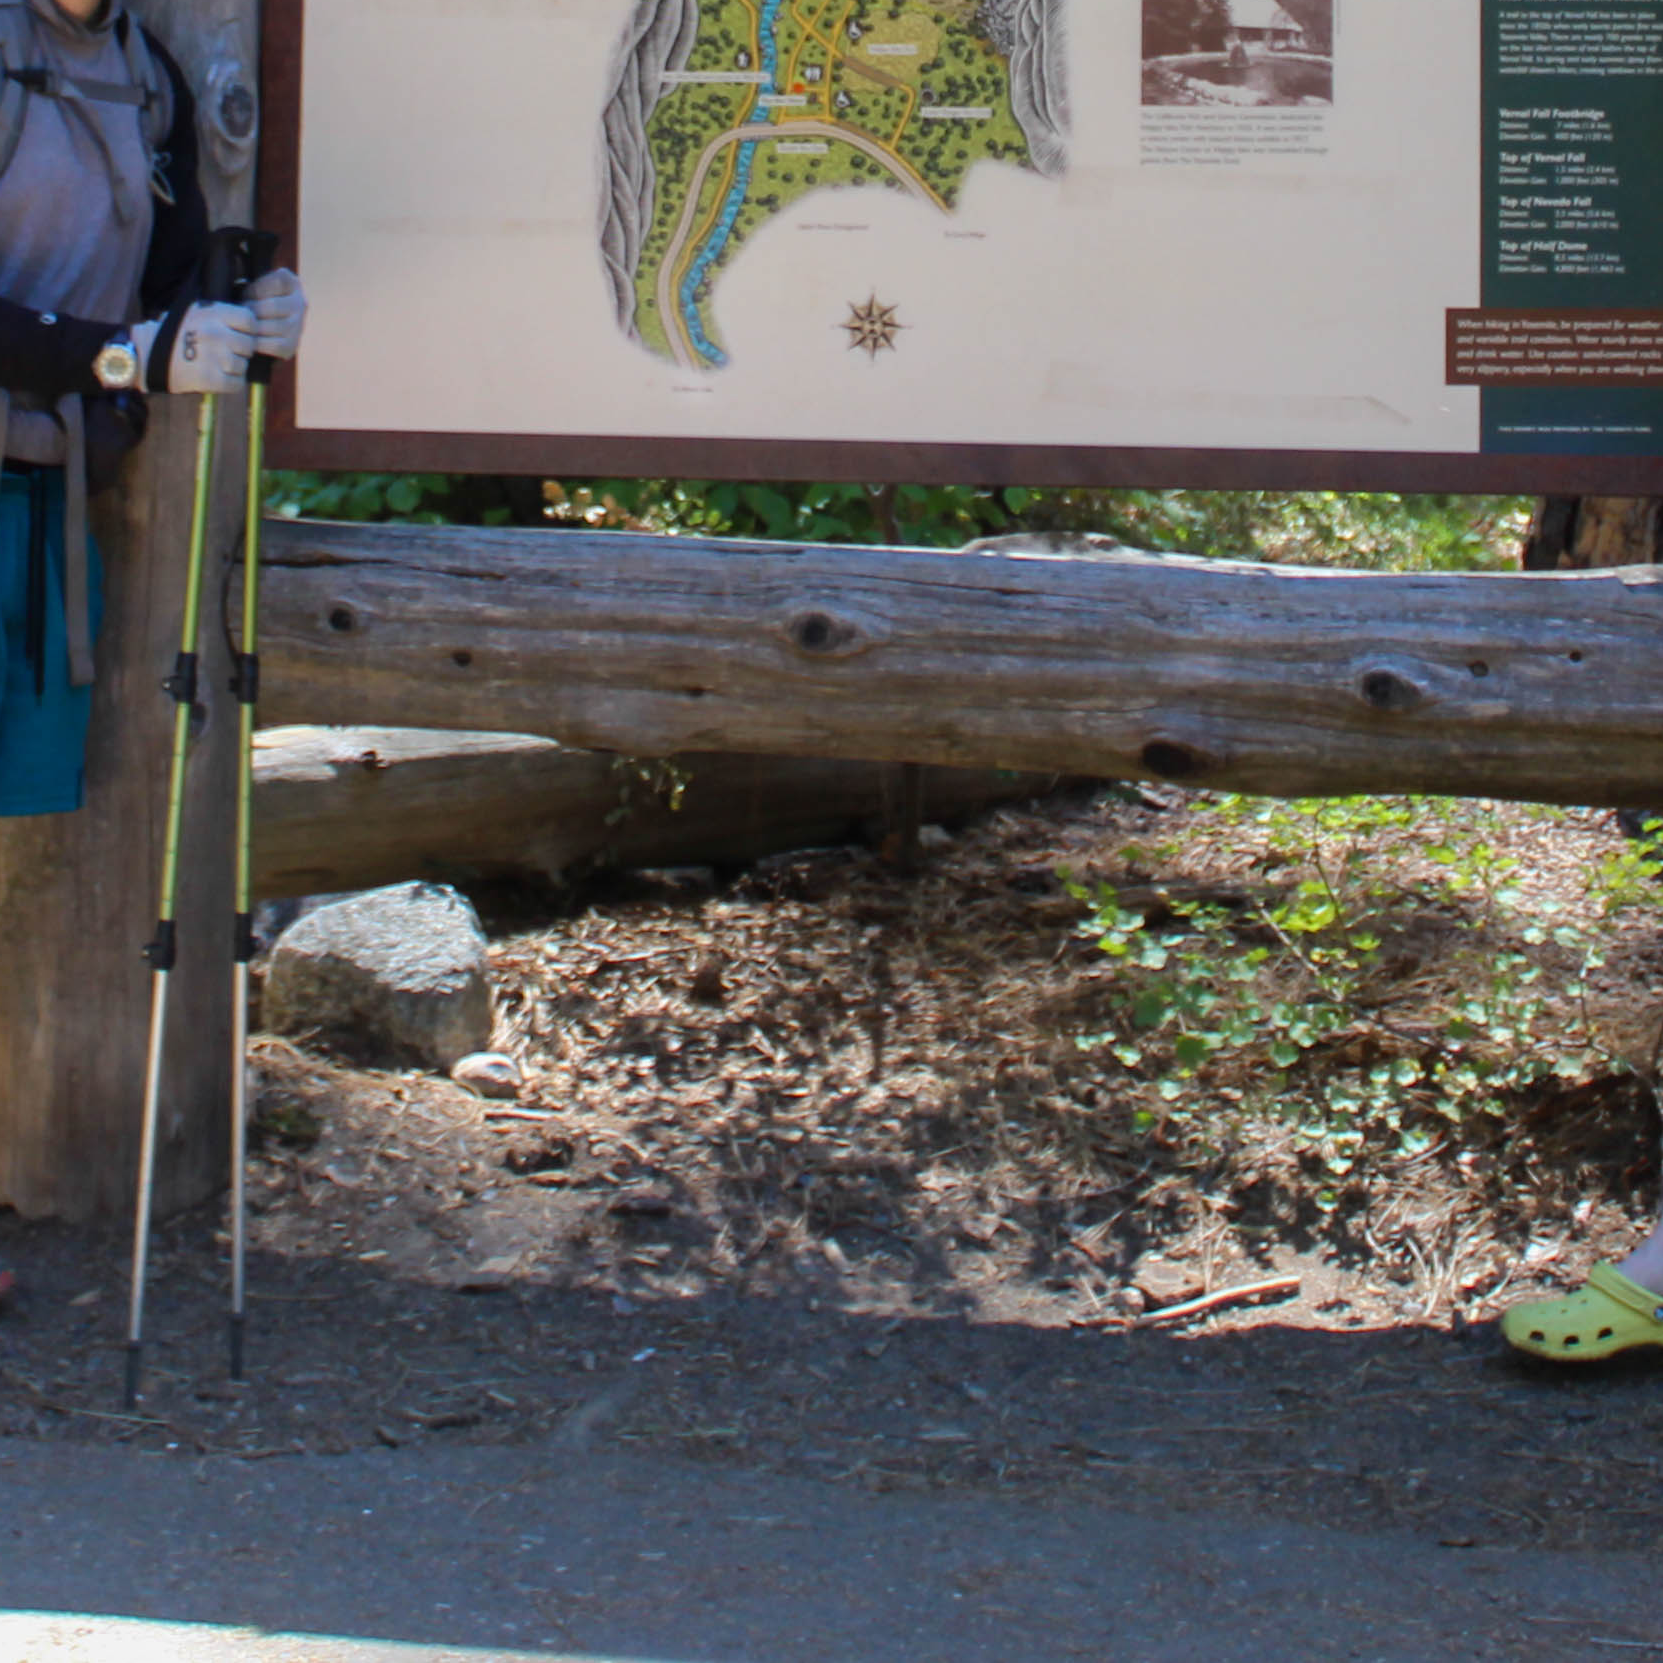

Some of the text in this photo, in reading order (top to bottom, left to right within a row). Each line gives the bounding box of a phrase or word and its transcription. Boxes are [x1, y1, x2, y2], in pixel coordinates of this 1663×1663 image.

[1500, 108, 1605, 120] Vernal Fall Footbridge
[1500, 152, 1586, 164] Top of Vernal Fall
[1500, 196, 1592, 208] Top of Nevada Fall
[1500, 240, 1588, 252] Top of Half Dome
